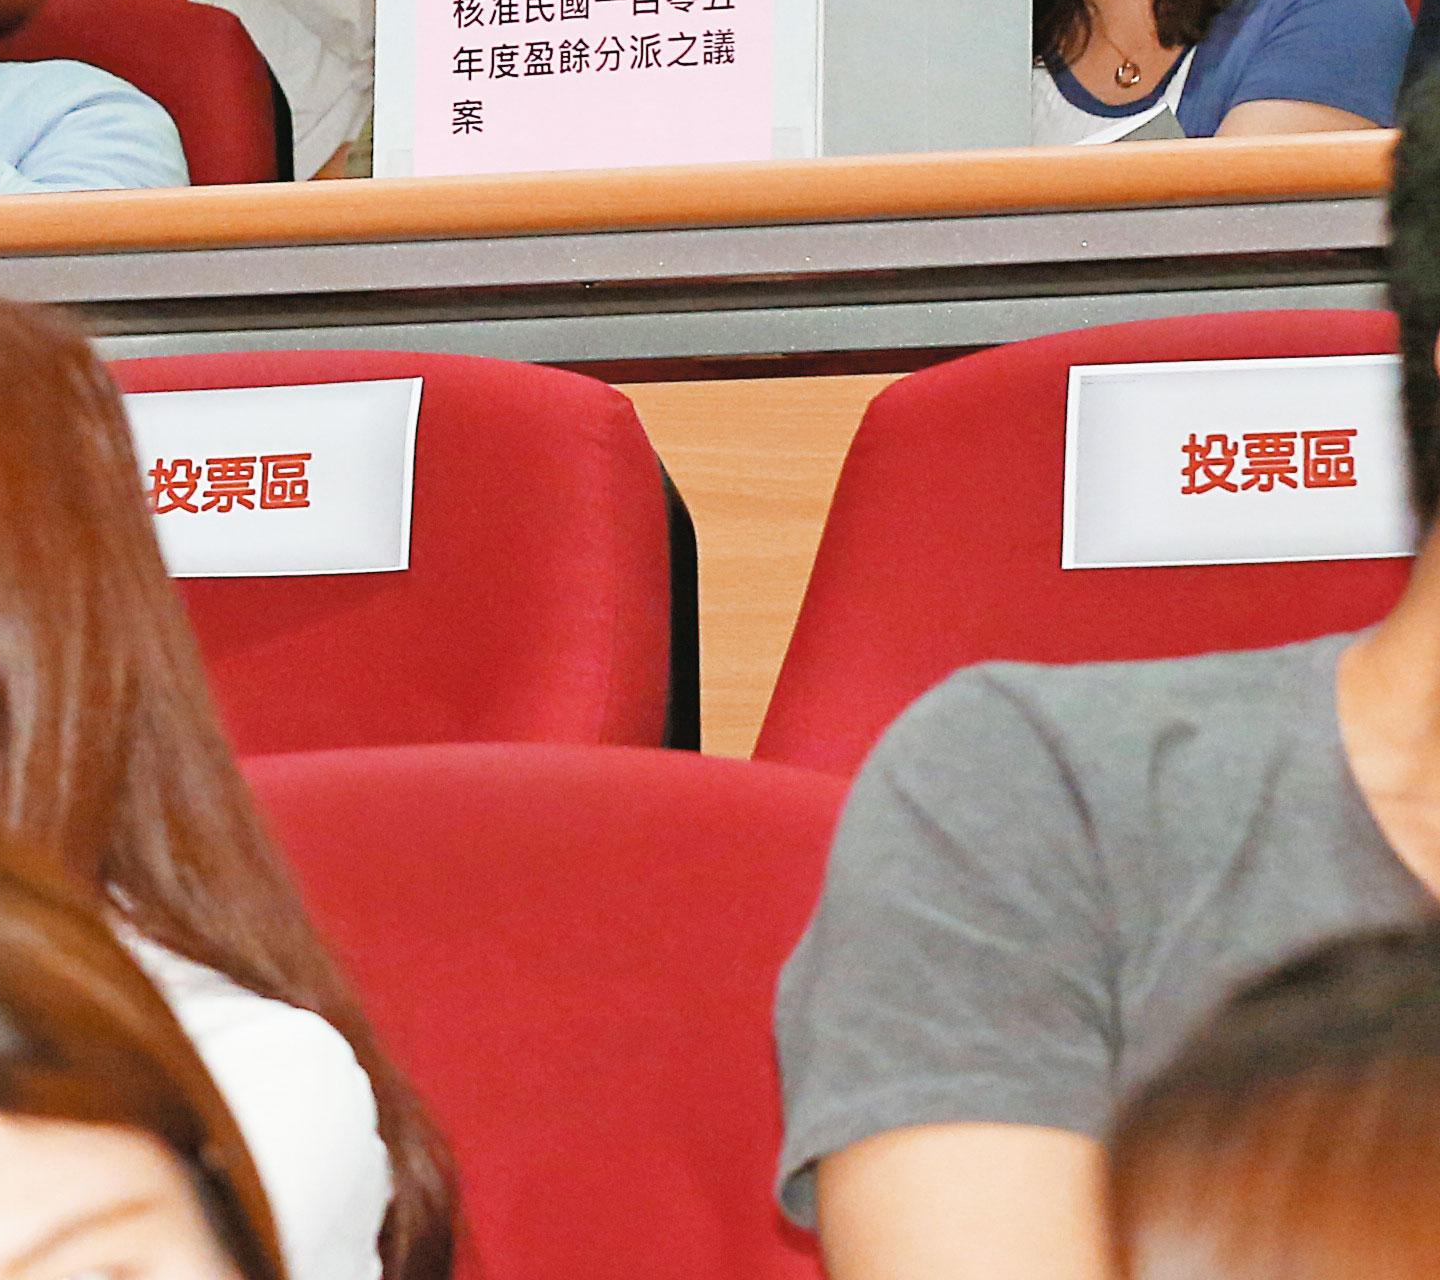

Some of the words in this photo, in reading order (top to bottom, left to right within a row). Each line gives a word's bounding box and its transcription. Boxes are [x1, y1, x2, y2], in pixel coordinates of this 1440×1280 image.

[451, 28, 736, 82] 年度盈餘分派之議
[451, 98, 484, 136] 案
[147, 452, 313, 515] 投票區
[1180, 427, 1359, 496] 投票區
